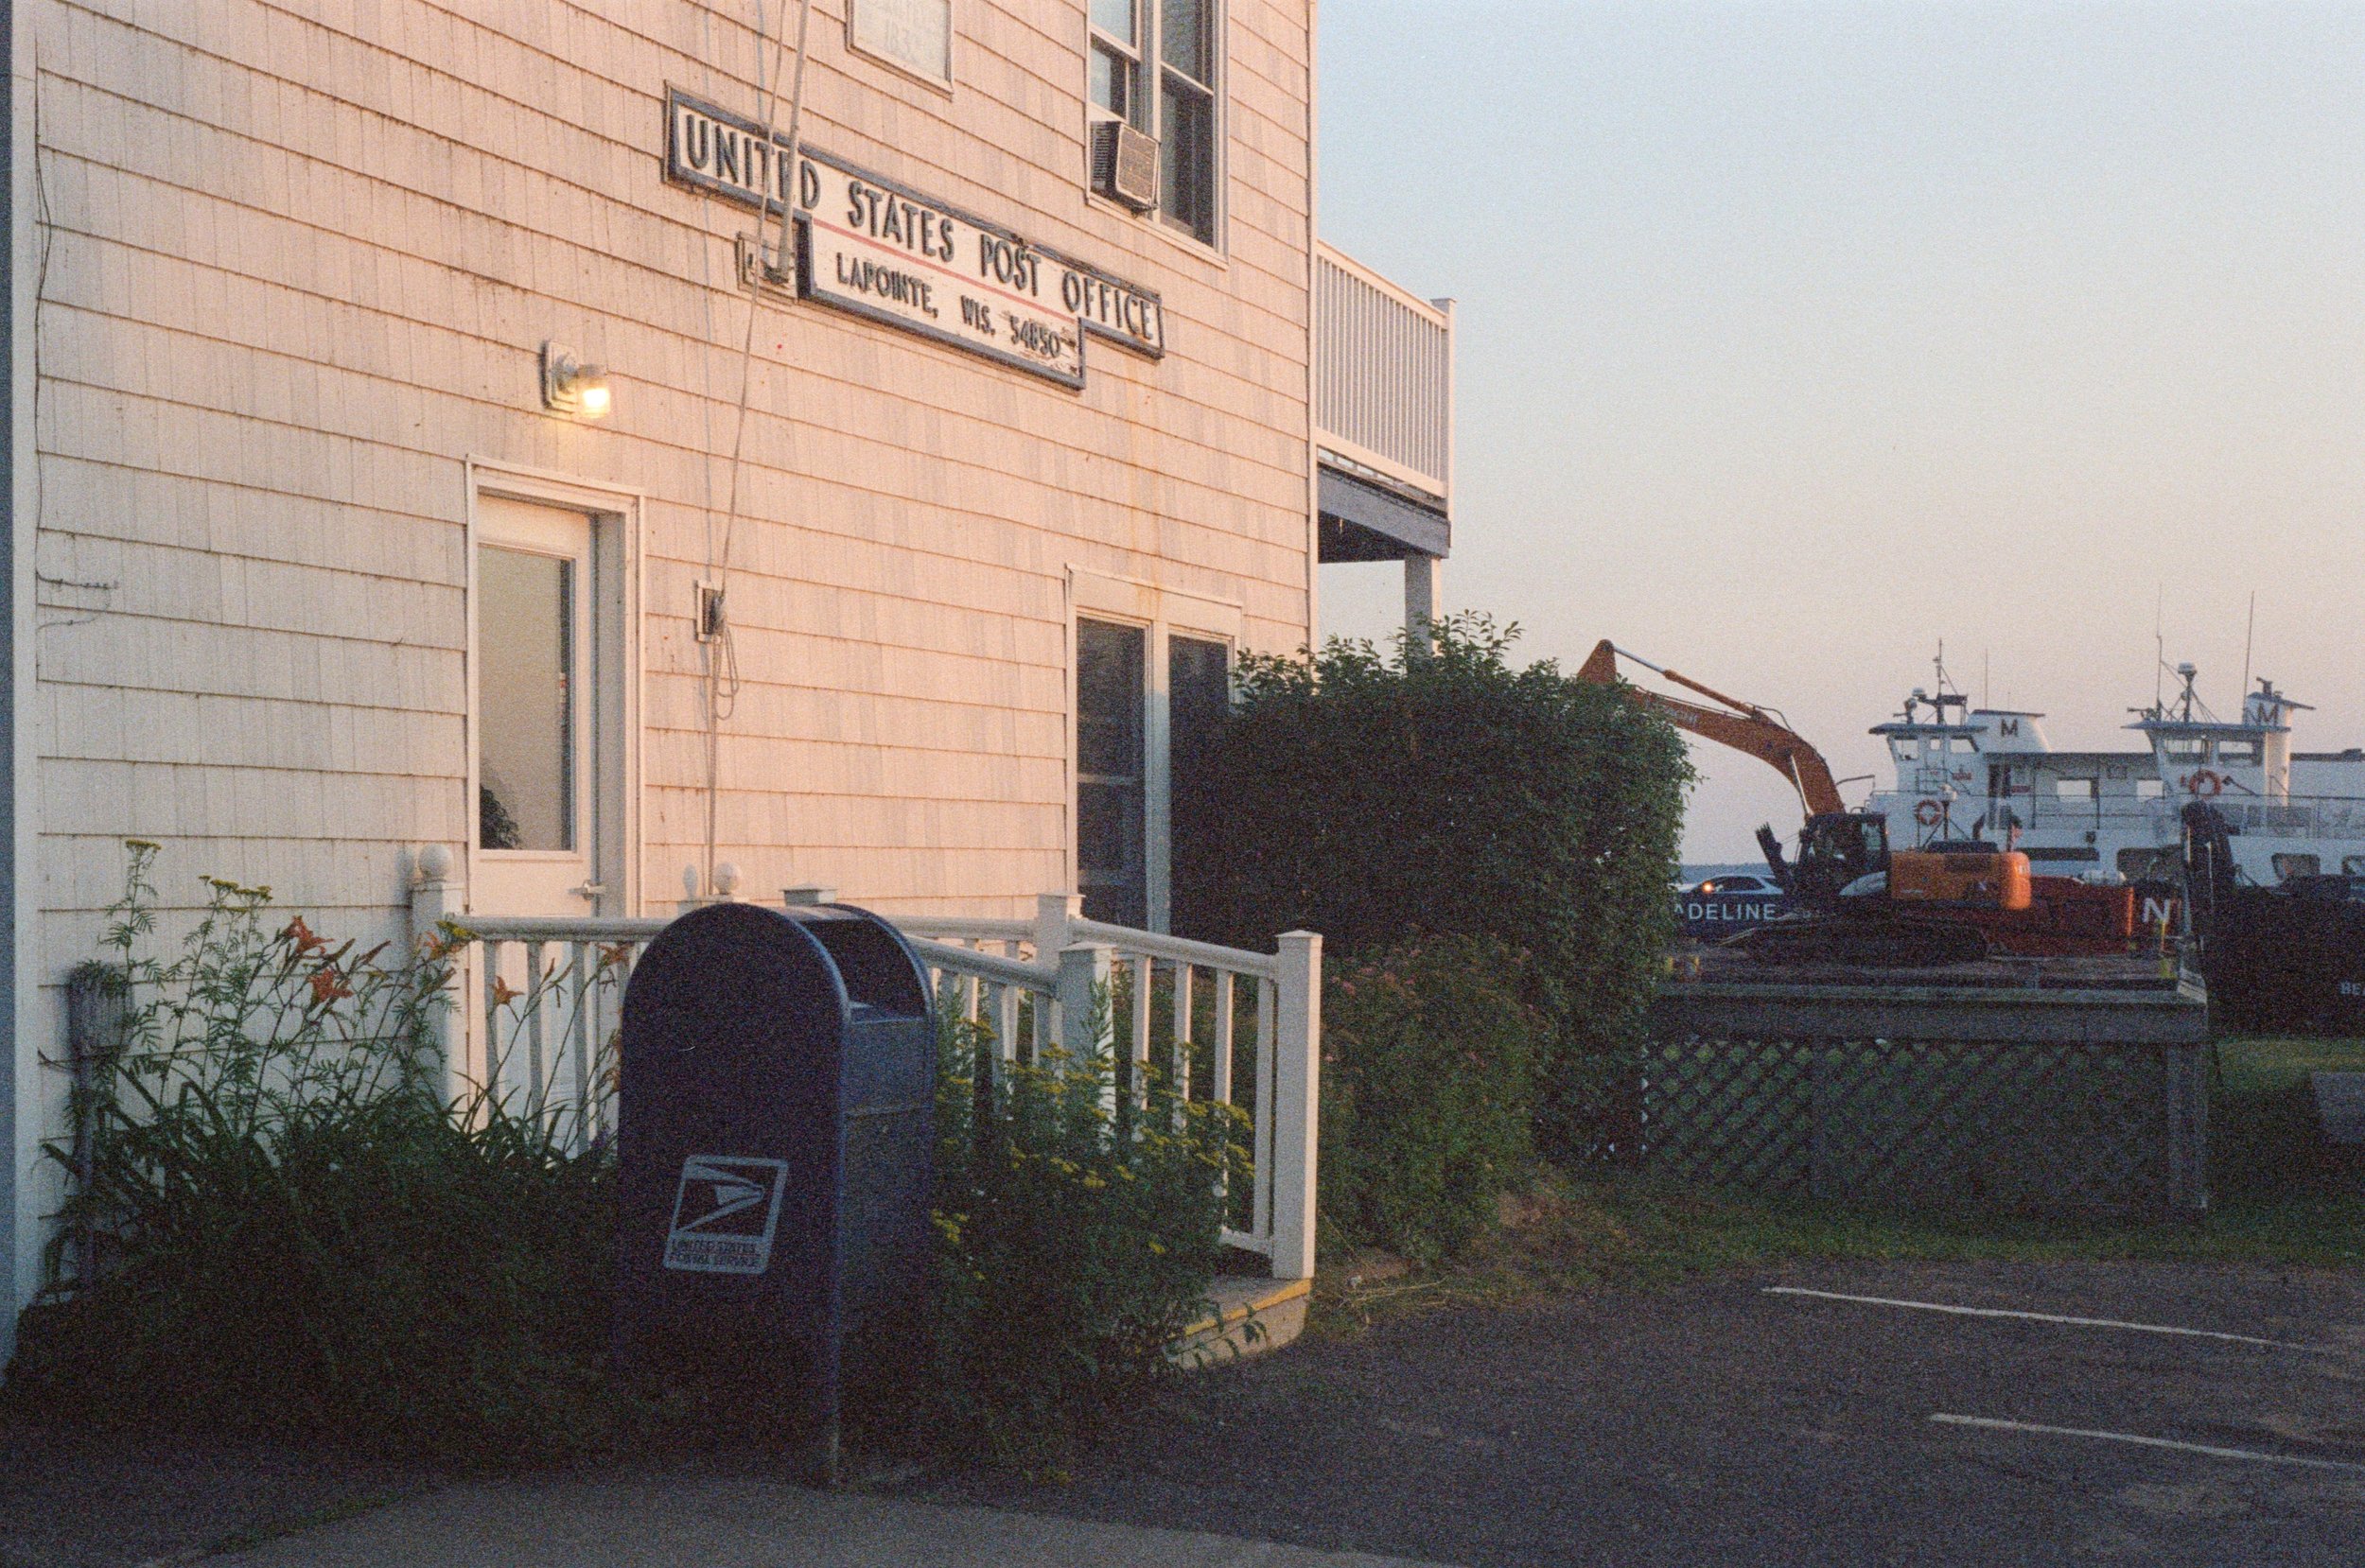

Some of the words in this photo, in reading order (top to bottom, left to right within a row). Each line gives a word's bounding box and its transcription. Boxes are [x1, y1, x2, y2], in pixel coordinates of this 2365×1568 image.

[836, 252, 939, 319] LAPOINTE,
[960, 294, 996, 337] WIS.
[1009, 315, 1061, 358] 54850
[848, 181, 955, 263] STATES
[980, 234, 1042, 297] POST
[1062, 271, 1153, 340] OFFICE
[2001, 718, 2020, 739] M
